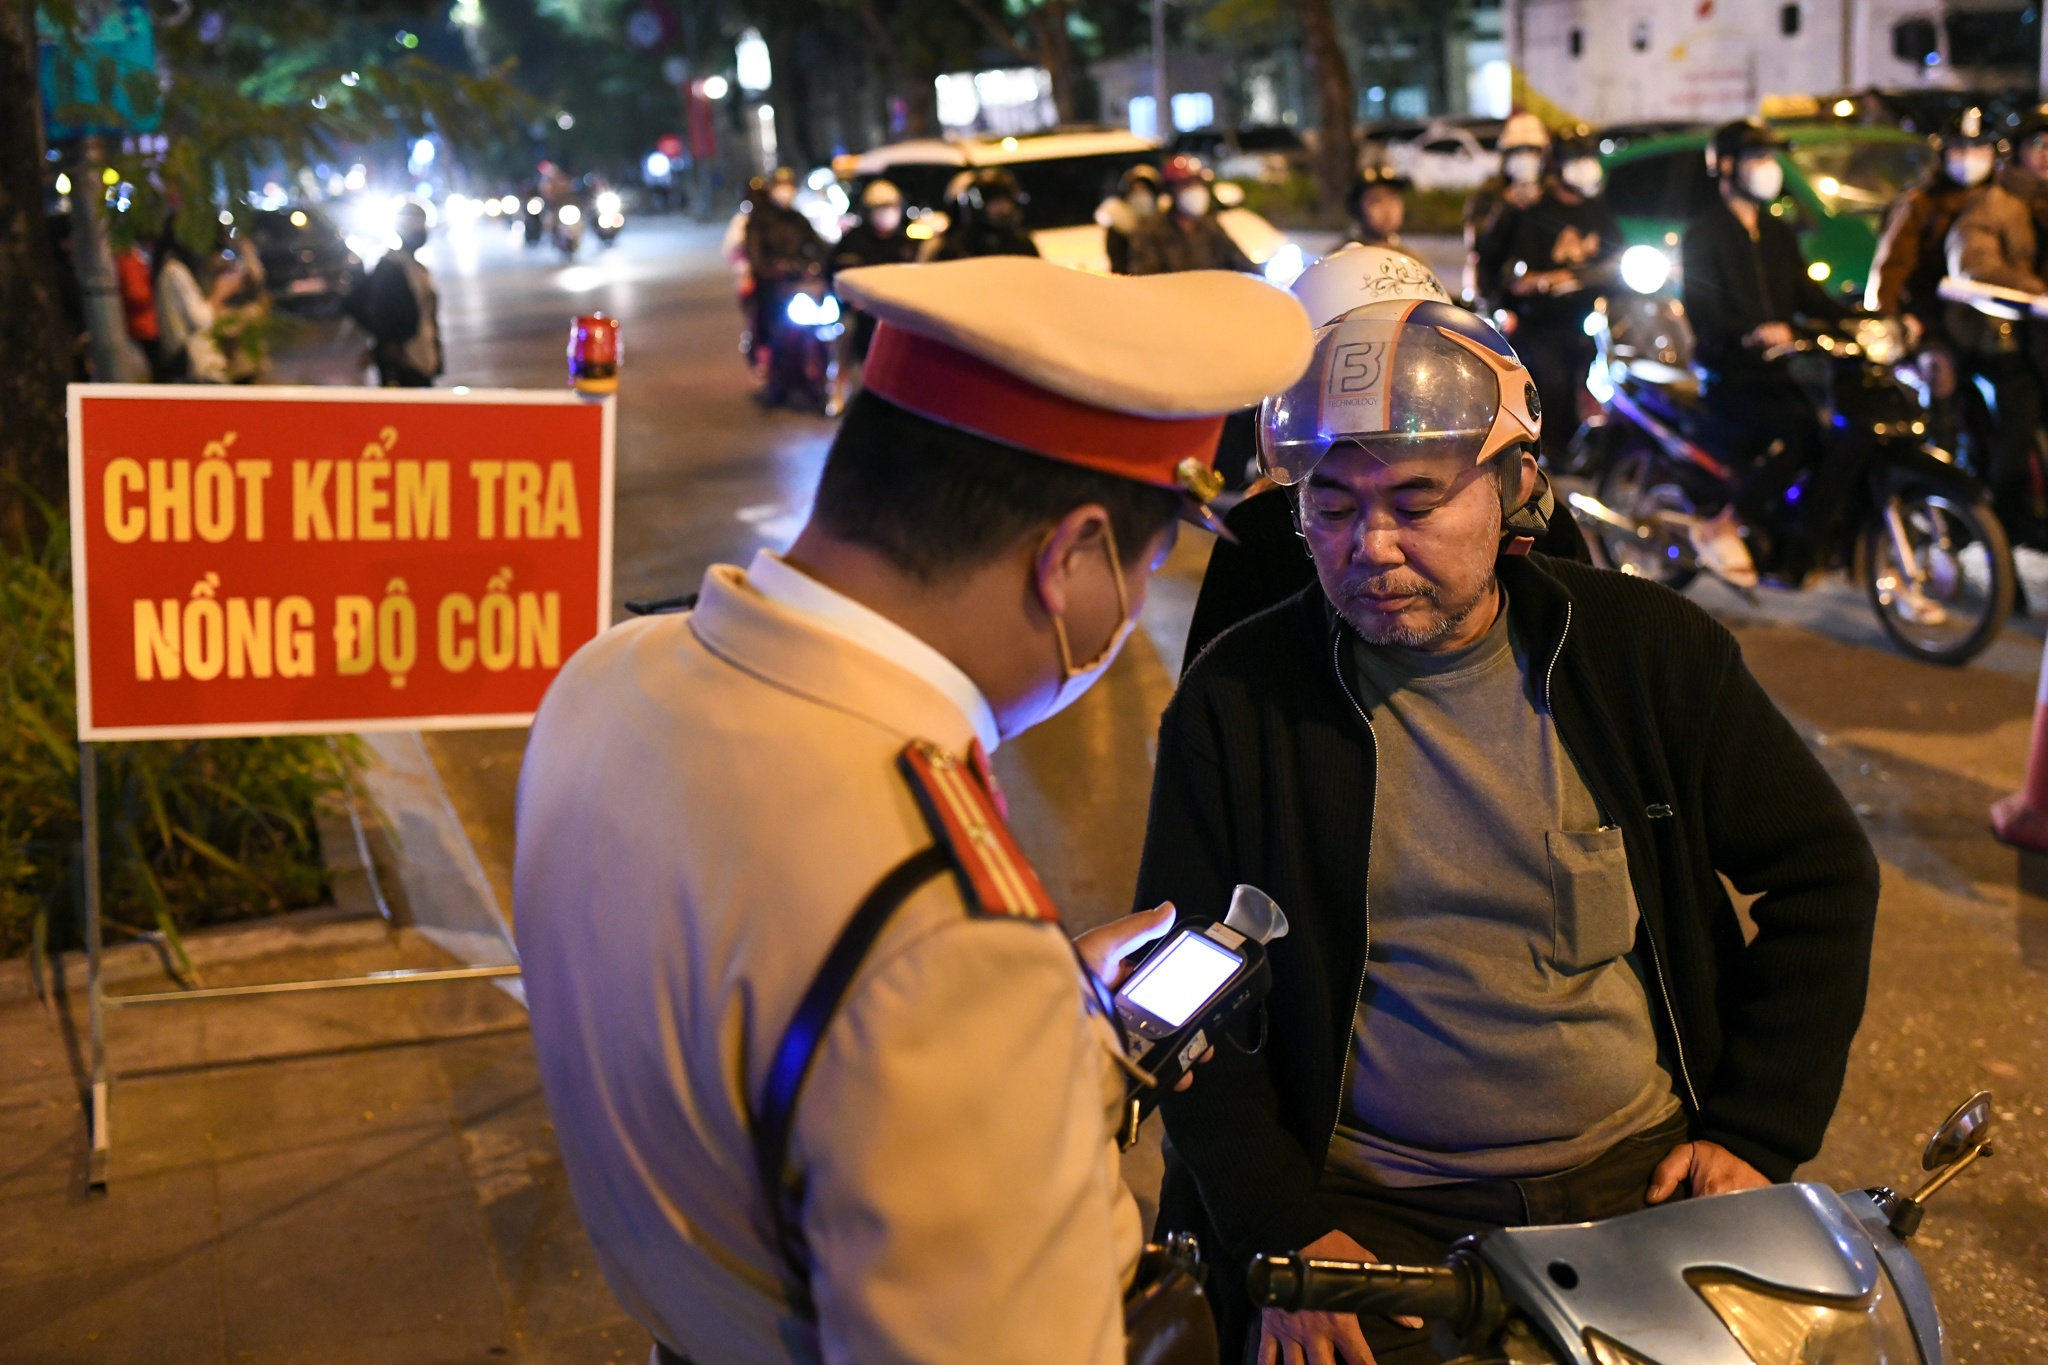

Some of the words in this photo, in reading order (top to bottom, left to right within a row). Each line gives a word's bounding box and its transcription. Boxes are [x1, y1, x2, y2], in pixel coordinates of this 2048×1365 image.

[1329, 397, 1378, 408] TECHNOLOGY
[102, 431, 272, 543] CHỐT
[292, 426, 451, 541] KIỂM
[469, 459, 582, 540] TRA
[133, 571, 316, 681] NỒNG
[332, 577, 417, 689] ĐỘ
[437, 566, 561, 672] CỒN
